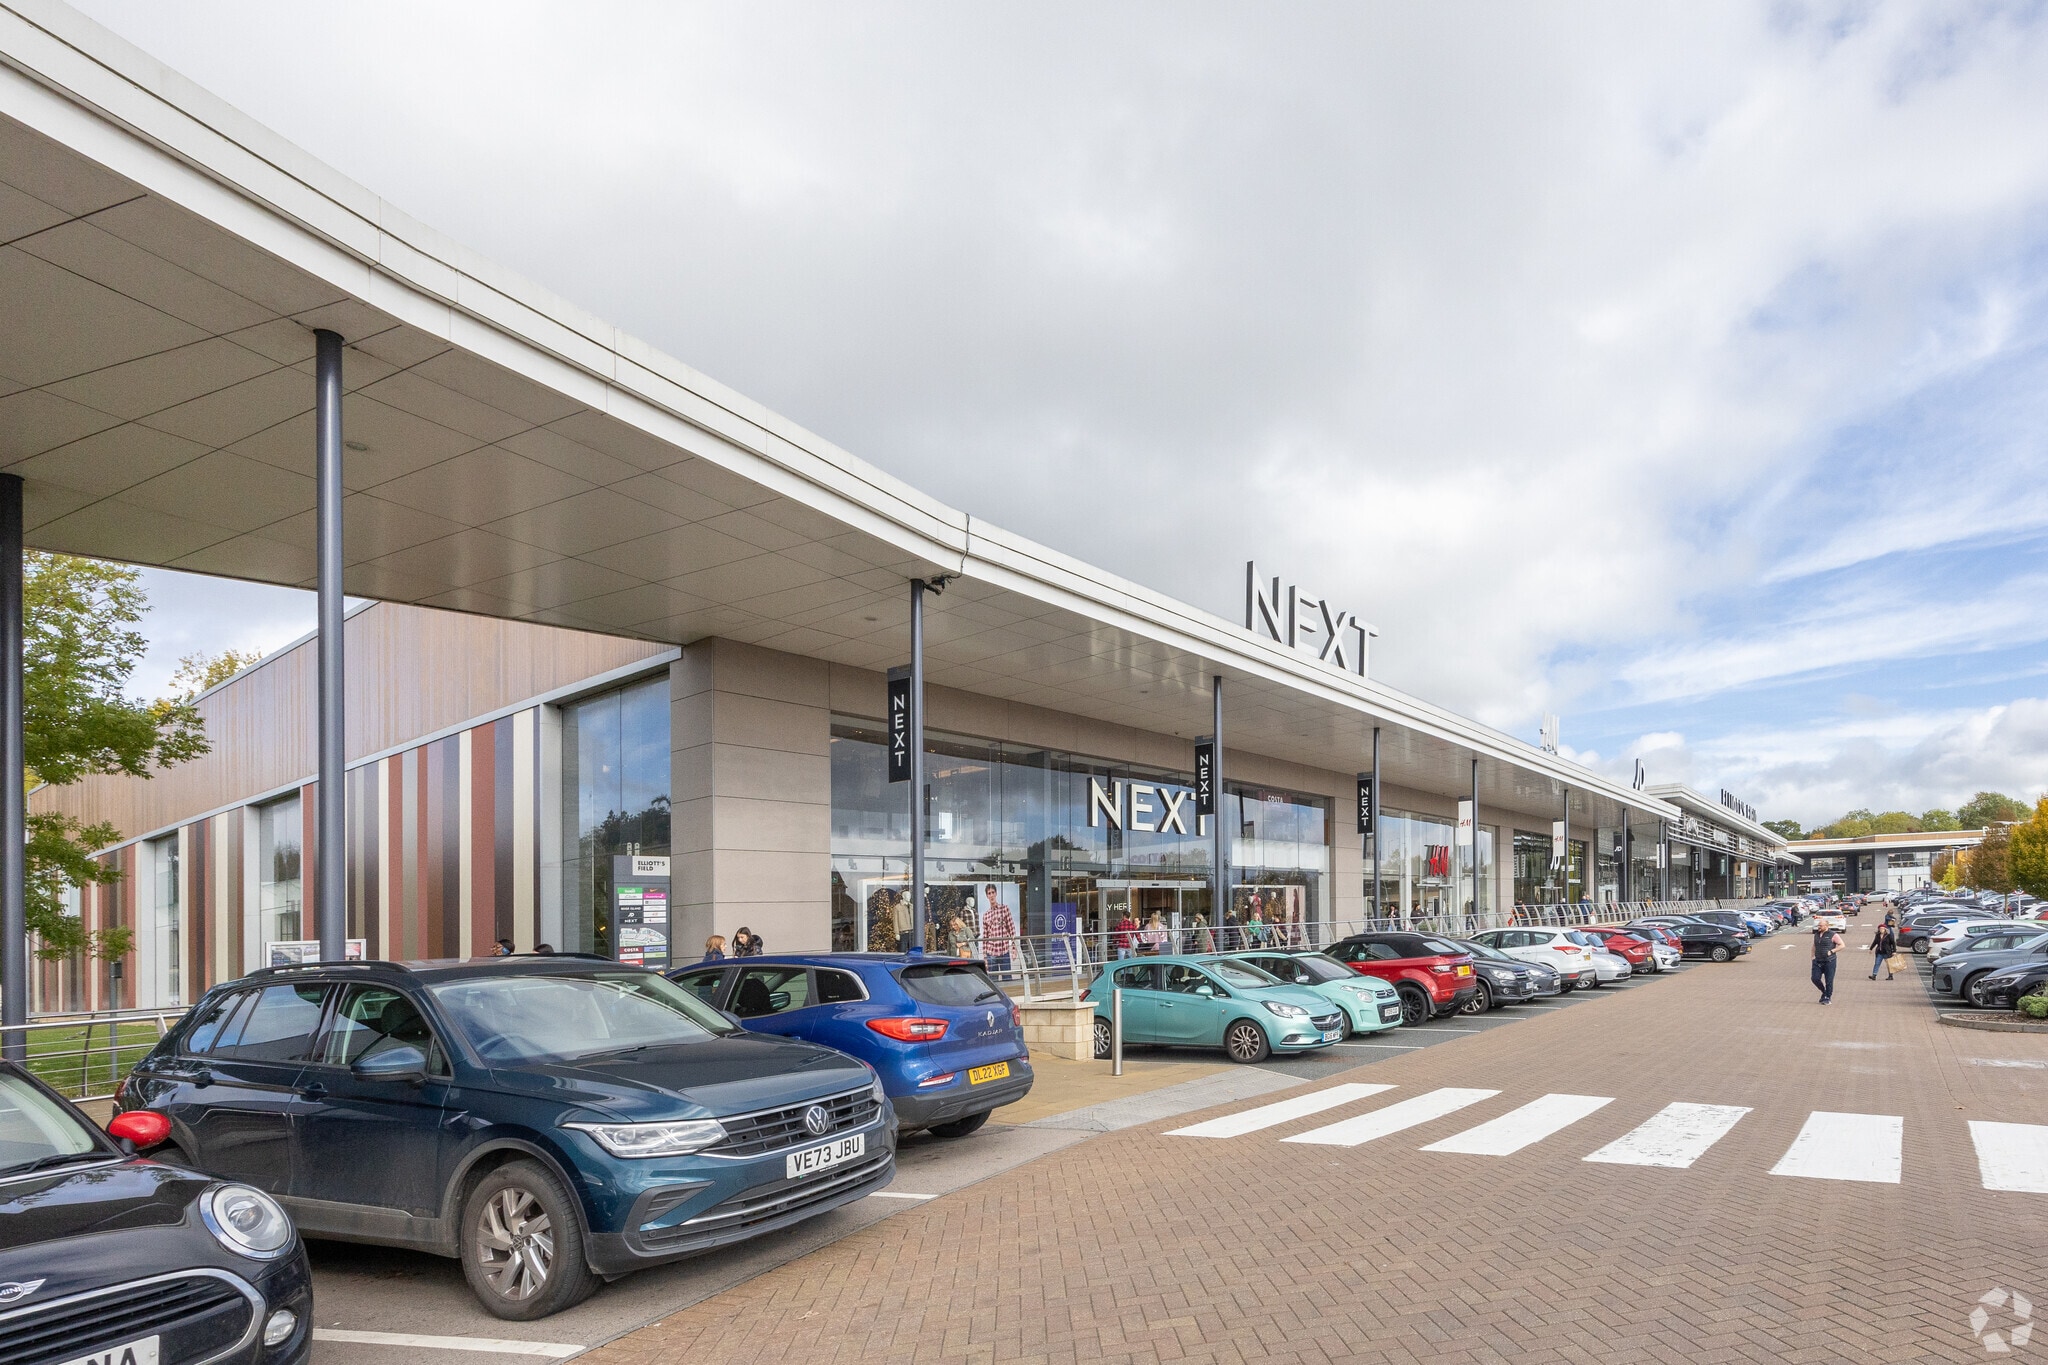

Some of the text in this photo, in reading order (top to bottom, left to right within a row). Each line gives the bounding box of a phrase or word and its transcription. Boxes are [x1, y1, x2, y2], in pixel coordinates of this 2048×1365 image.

[1245, 560, 1379, 678] NEXT
[893, 693, 905, 767] NEXT
[1200, 754, 1209, 805] NEXT
[1633, 758, 1645, 791] JD
[1361, 787, 1369, 826] NEXT
[978, 1028, 1002, 1037] KADJAR
[973, 1067, 992, 1081] DL22
[794, 1136, 860, 1172] VE73 JBU
